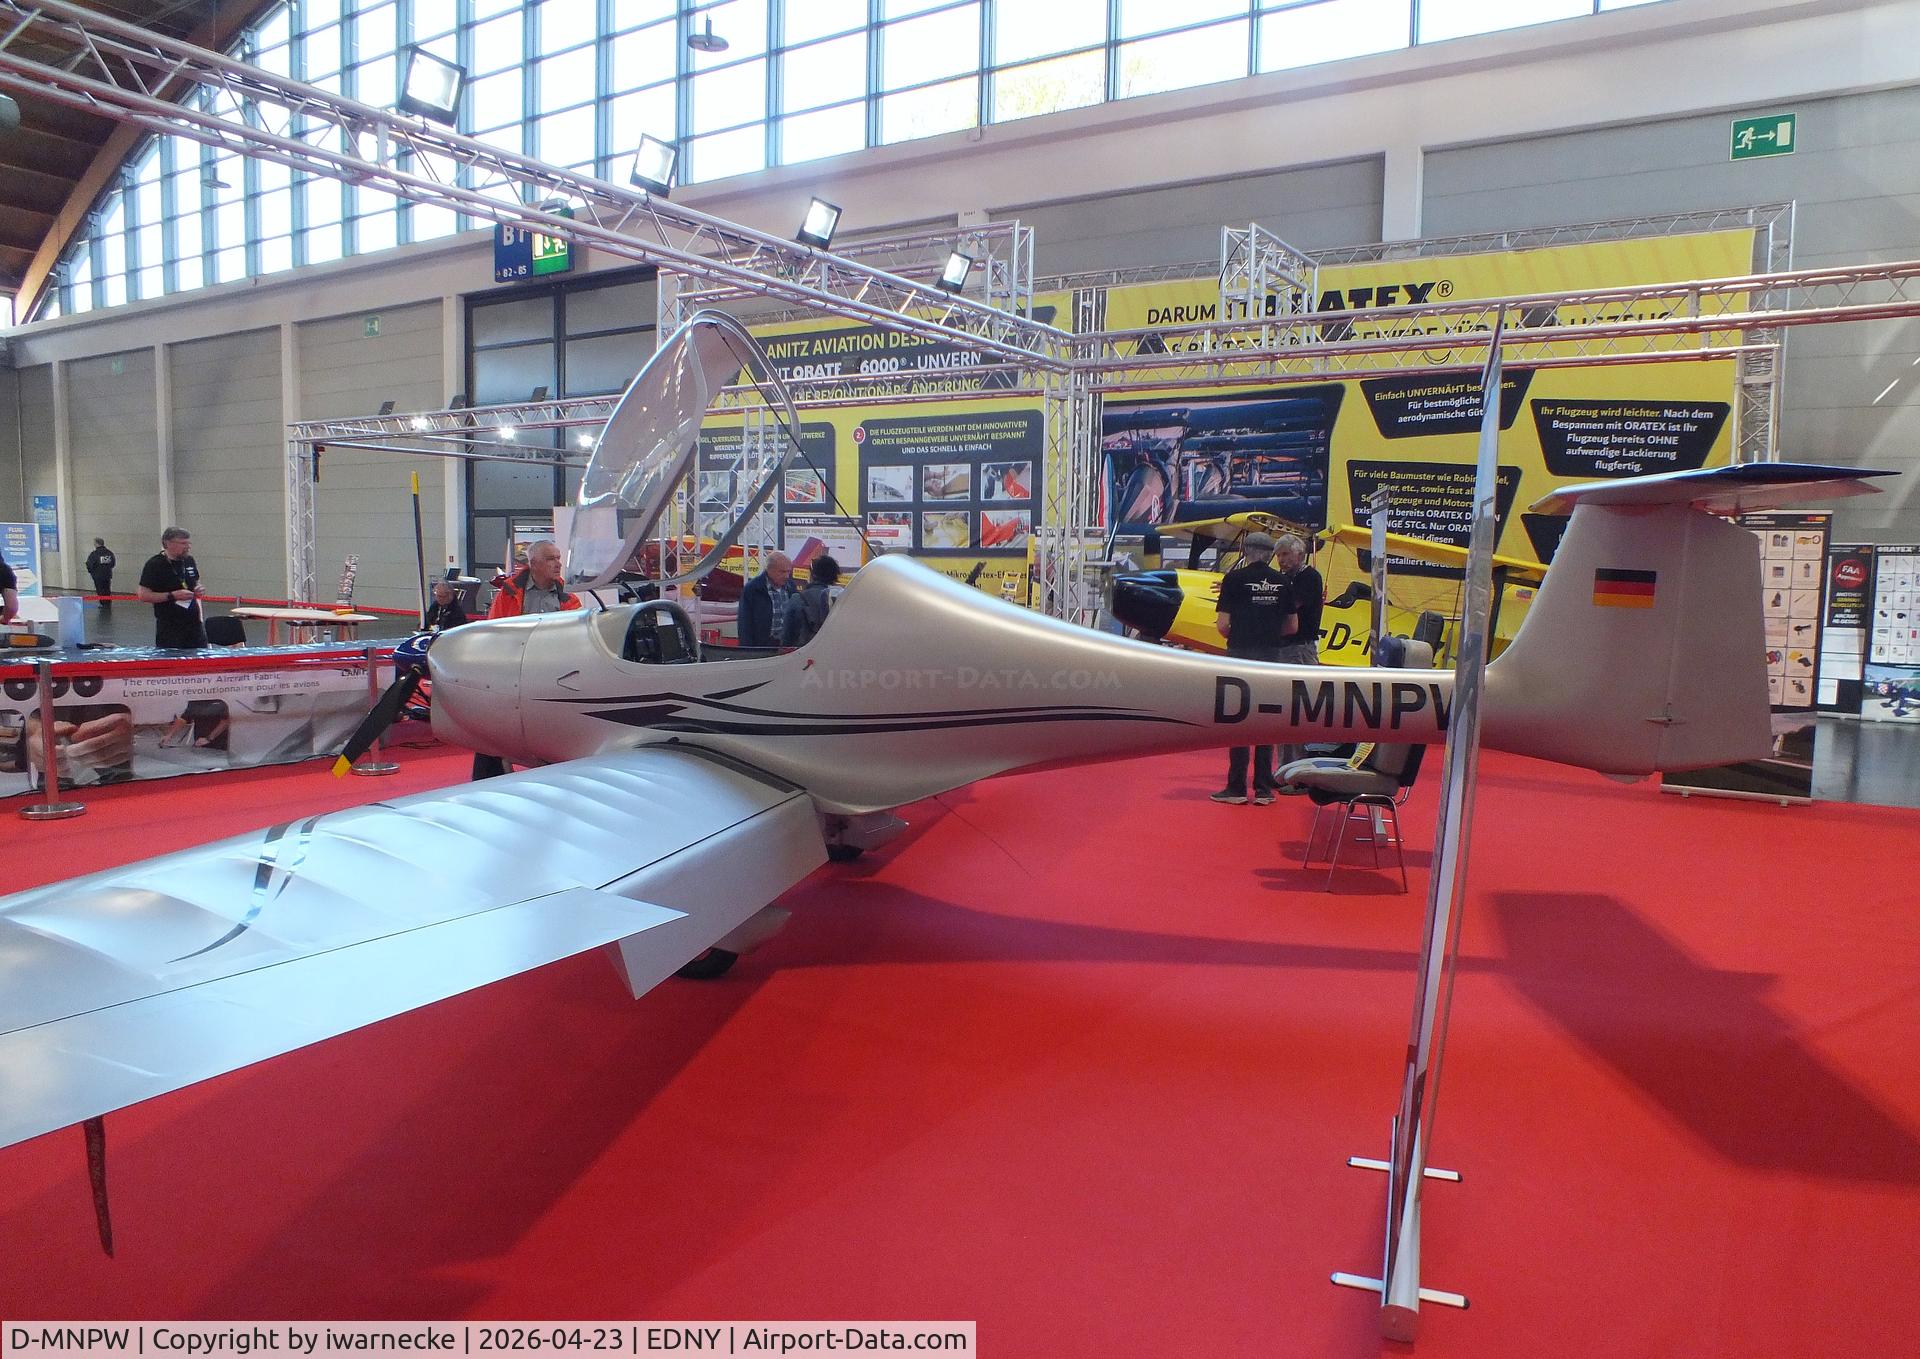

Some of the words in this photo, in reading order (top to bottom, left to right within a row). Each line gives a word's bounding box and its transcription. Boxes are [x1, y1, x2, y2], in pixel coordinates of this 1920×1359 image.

[1148, 303, 1216, 324] DARUM
[767, 339, 810, 360] ANITZ
[812, 332, 884, 356] AVIATION
[910, 378, 980, 395] ÄNDERUNG
[1375, 389, 1405, 400] Einfach
[1407, 384, 1465, 398] UNVERNÄHT
[1408, 402, 1421, 410] Für
[1424, 396, 1480, 409] bestmögliche
[1398, 412, 1465, 423] aerodynamische
[1468, 408, 1484, 417] Güt
[1541, 407, 1554, 415] Ihr
[1556, 407, 1598, 418] Flugzeug
[1600, 408, 1621, 416] wird
[1623, 408, 1660, 417] leichter.
[1664, 409, 1689, 418] Nach
[1691, 410, 1713, 419] dem
[880, 426, 927, 436] FLUGZEUGTEILE
[928, 425, 954, 434] WERDEN
[982, 420, 1028, 430] INNOVATIVEN
[1552, 420, 1603, 430] Bespannen
[1606, 421, 1622, 430] mit
[1624, 422, 1665, 431] ORATEX
[1668, 422, 1681, 432] ist
[1683, 423, 1698, 432] Ihr
[950, 432, 990, 442] UNVERNÄHT
[991, 431, 1026, 440] BESPANNT
[1566, 434, 1609, 444] Flugzeug
[1611, 434, 1645, 444] bereits
[1647, 436, 1679, 445] OHNE
[1566, 447, 1620, 458] aufwendige
[1622, 448, 1677, 460] Lackierung
[1595, 460, 1643, 472] flugfertig.
[1354, 469, 1367, 478] Für
[1369, 470, 1388, 479] viele
[1390, 471, 1436, 481] Baumuster
[1437, 473, 1452, 482] wie
[1446, 487, 1463, 495] fast
[1424, 498, 1440, 506] und
[1396, 508, 1425, 517] bereits
[1426, 510, 1463, 519] ORATEX
[1404, 522, 1427, 530] STCs.
[1430, 522, 1445, 530] Nur
[1426, 536, 1454, 544] diesen
[1842, 565, 1860, 574] FAA
[146, 677, 212, 686] revolutionary
[216, 674, 250, 683] Aircraft
[254, 672, 280, 681] Fabric
[256, 683, 277, 692] pour
[293, 680, 320, 688] avions
